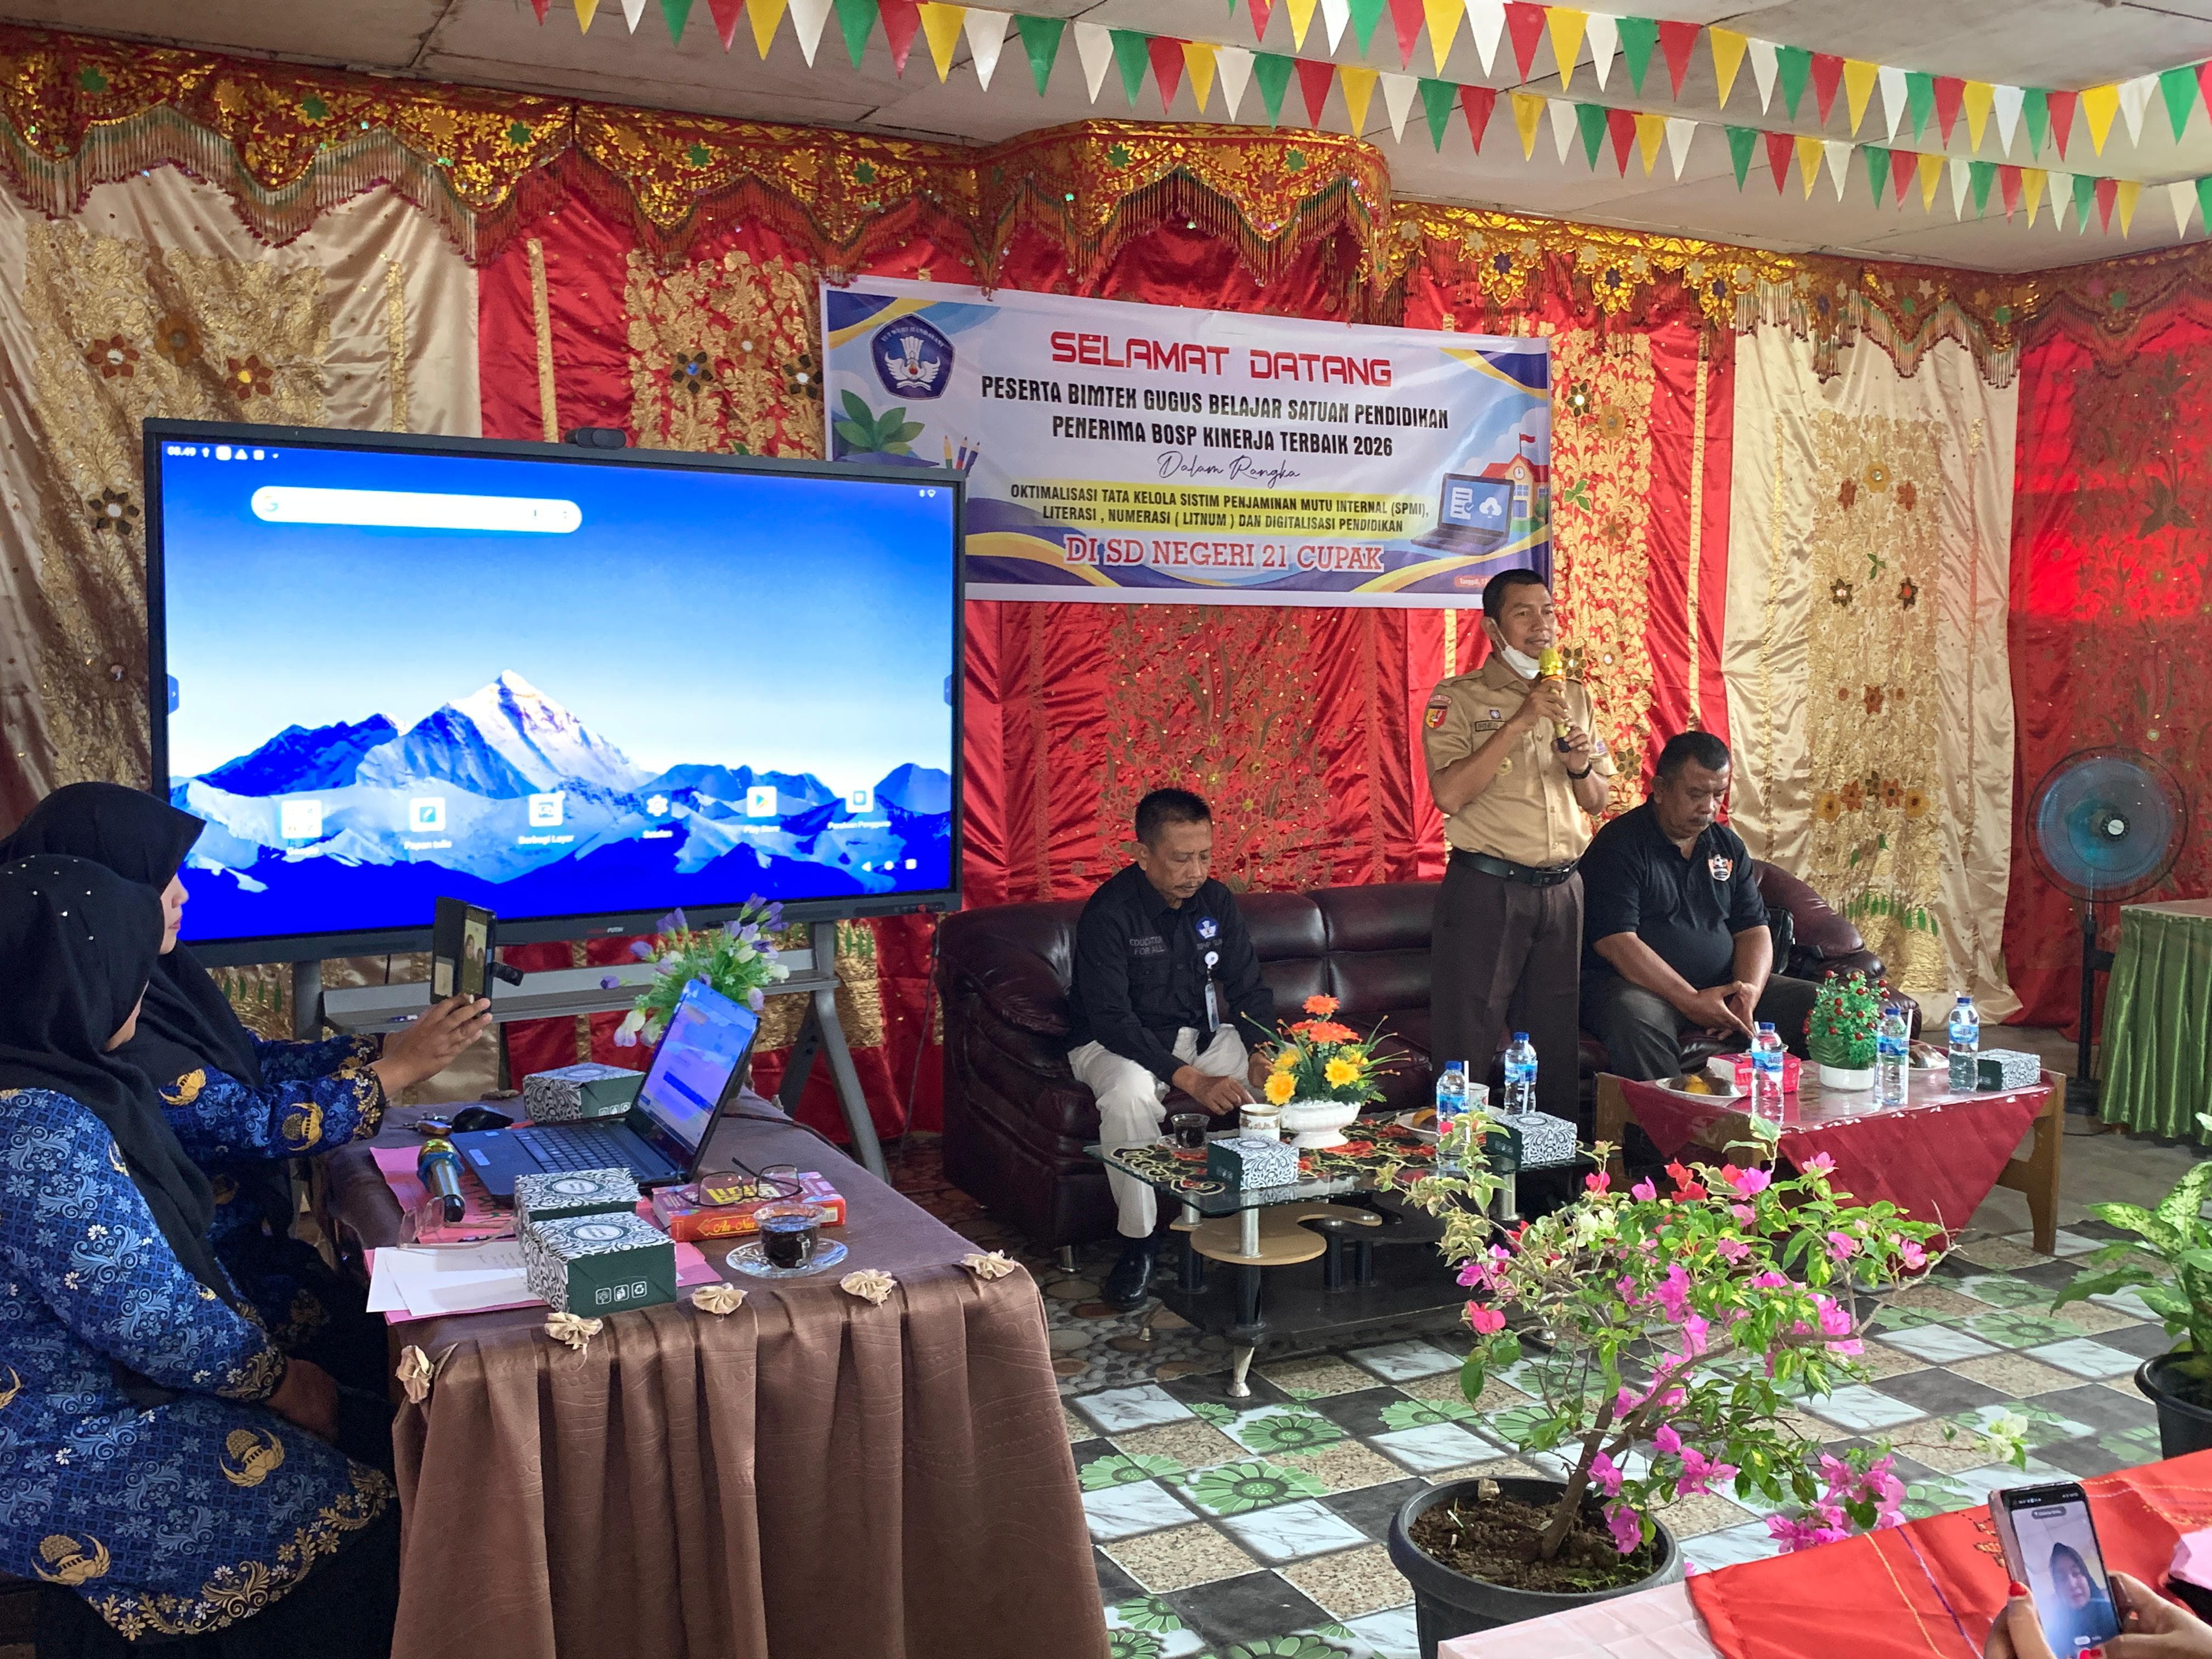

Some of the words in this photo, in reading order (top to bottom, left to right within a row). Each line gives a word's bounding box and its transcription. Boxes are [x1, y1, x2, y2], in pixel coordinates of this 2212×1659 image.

[1051, 331, 1229, 375] SELAMAT
[1250, 349, 1392, 387] DATANG
[981, 376, 1062, 403] PESERTA
[1068, 383, 1137, 409] BIMTEK
[1144, 390, 1201, 413] GUGUS
[1209, 393, 1282, 419] BELAJAR
[1288, 399, 1349, 424] SATUAN
[1355, 404, 1448, 429] PENDIDIKAN
[1053, 415, 1146, 442] PENERIMA
[1153, 424, 1197, 446] BOSP
[1203, 426, 1274, 451] KINERJA
[1280, 431, 1349, 455] TERBAIK
[1353, 436, 1393, 457] 2026
[1157, 450, 1224, 478] Dalam
[1229, 454, 1301, 489] Rangka
[1011, 483, 1097, 501] OKTIMALISASI
[1102, 489, 1129, 503] TATA
[1133, 491, 1177, 505] KELOLA
[1180, 493, 1220, 507] SISTIM
[1223, 495, 1297, 510] PENJAMINAN
[1301, 498, 1333, 511] MUTU
[1336, 500, 1387, 514] INTERNAL
[1391, 501, 1429, 517] (SPMI),
[1042, 505, 1096, 521] LITERASI
[1108, 509, 1170, 524] NUMERASI
[1183, 511, 1226, 527] LITNUM
[1239, 514, 1261, 527] DAN
[1265, 515, 1335, 530] DIGITALISASI
[1339, 518, 1403, 532] PENDIDIKAN
[1066, 537, 1098, 562] DI
[1106, 538, 1144, 563] SD
[1152, 540, 1255, 567] NEGERI
[1262, 544, 1286, 568] 21
[1297, 545, 1384, 570] CUPAK
